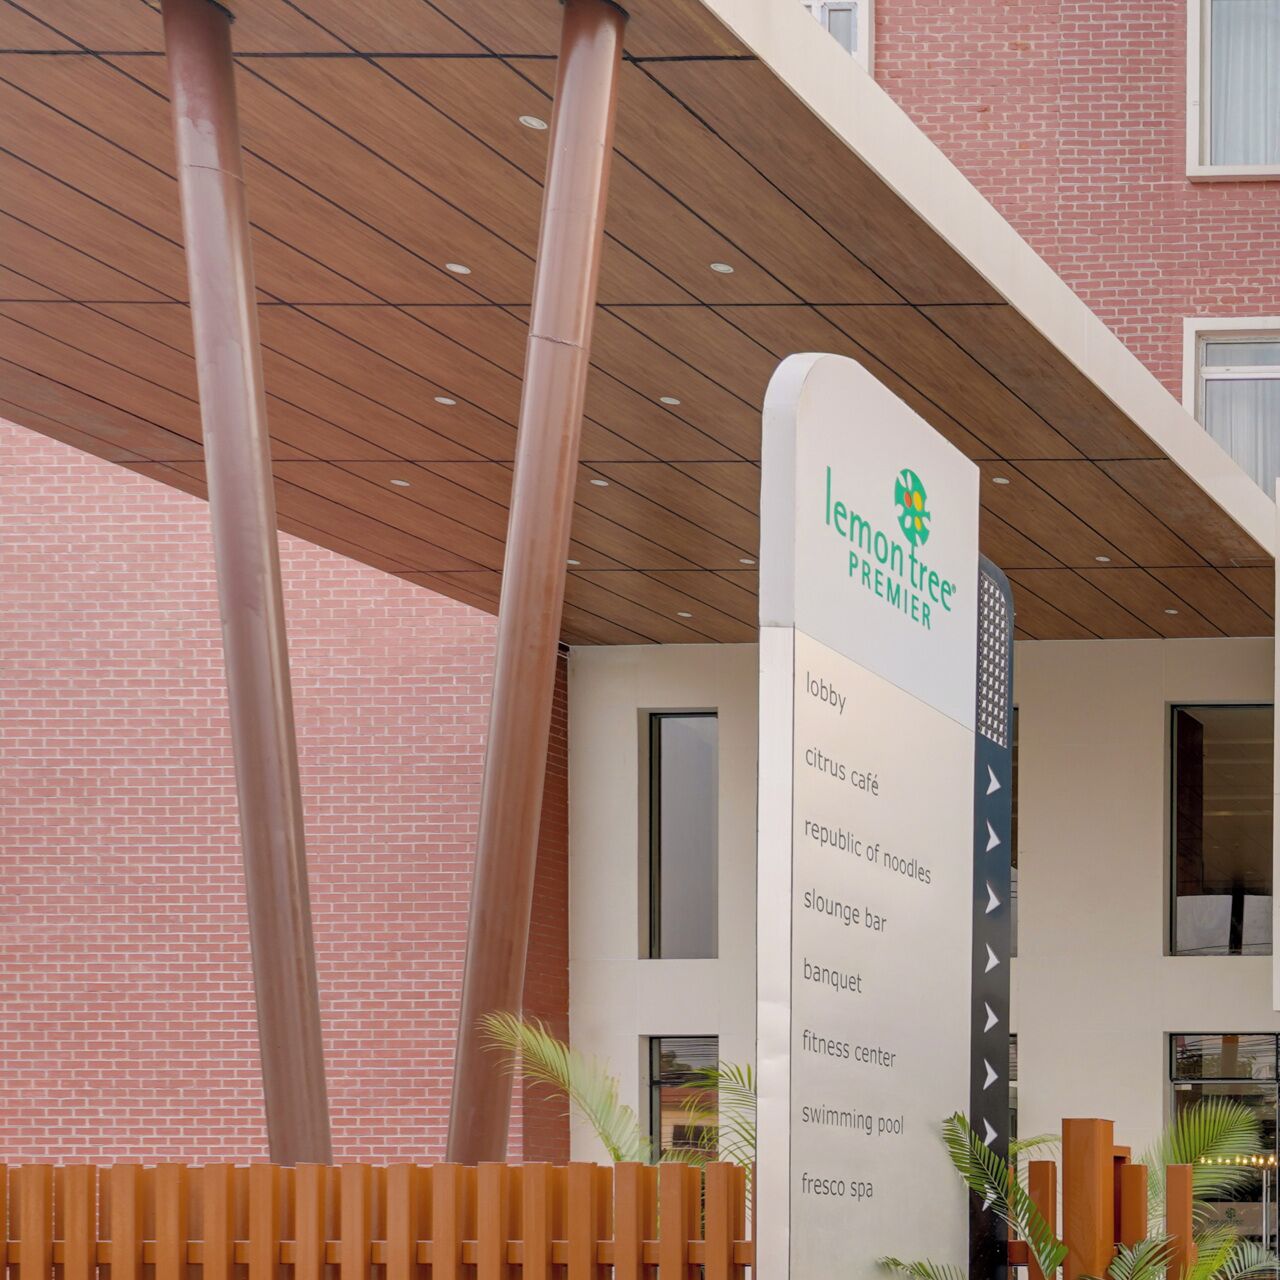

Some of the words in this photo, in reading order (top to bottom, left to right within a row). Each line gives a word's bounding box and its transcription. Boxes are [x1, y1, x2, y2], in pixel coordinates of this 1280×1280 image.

[826, 465, 903, 577] lemon
[848, 550, 931, 631] PREMIER
[806, 670, 848, 716] lobby
[804, 746, 847, 782] citrus
[850, 770, 880, 797] café
[804, 818, 862, 860] republic
[866, 842, 881, 864] of
[883, 851, 932, 885] noodles
[803, 887, 861, 927] slounge
[865, 905, 888, 934] bar
[803, 957, 863, 994] banquet
[802, 1029, 850, 1059] fitness
[854, 1045, 897, 1068] center
[802, 1104, 873, 1136] swimming
[878, 1115, 905, 1137] pool
[801, 1171, 846, 1197] fresco
[850, 1180, 874, 1202] spa
